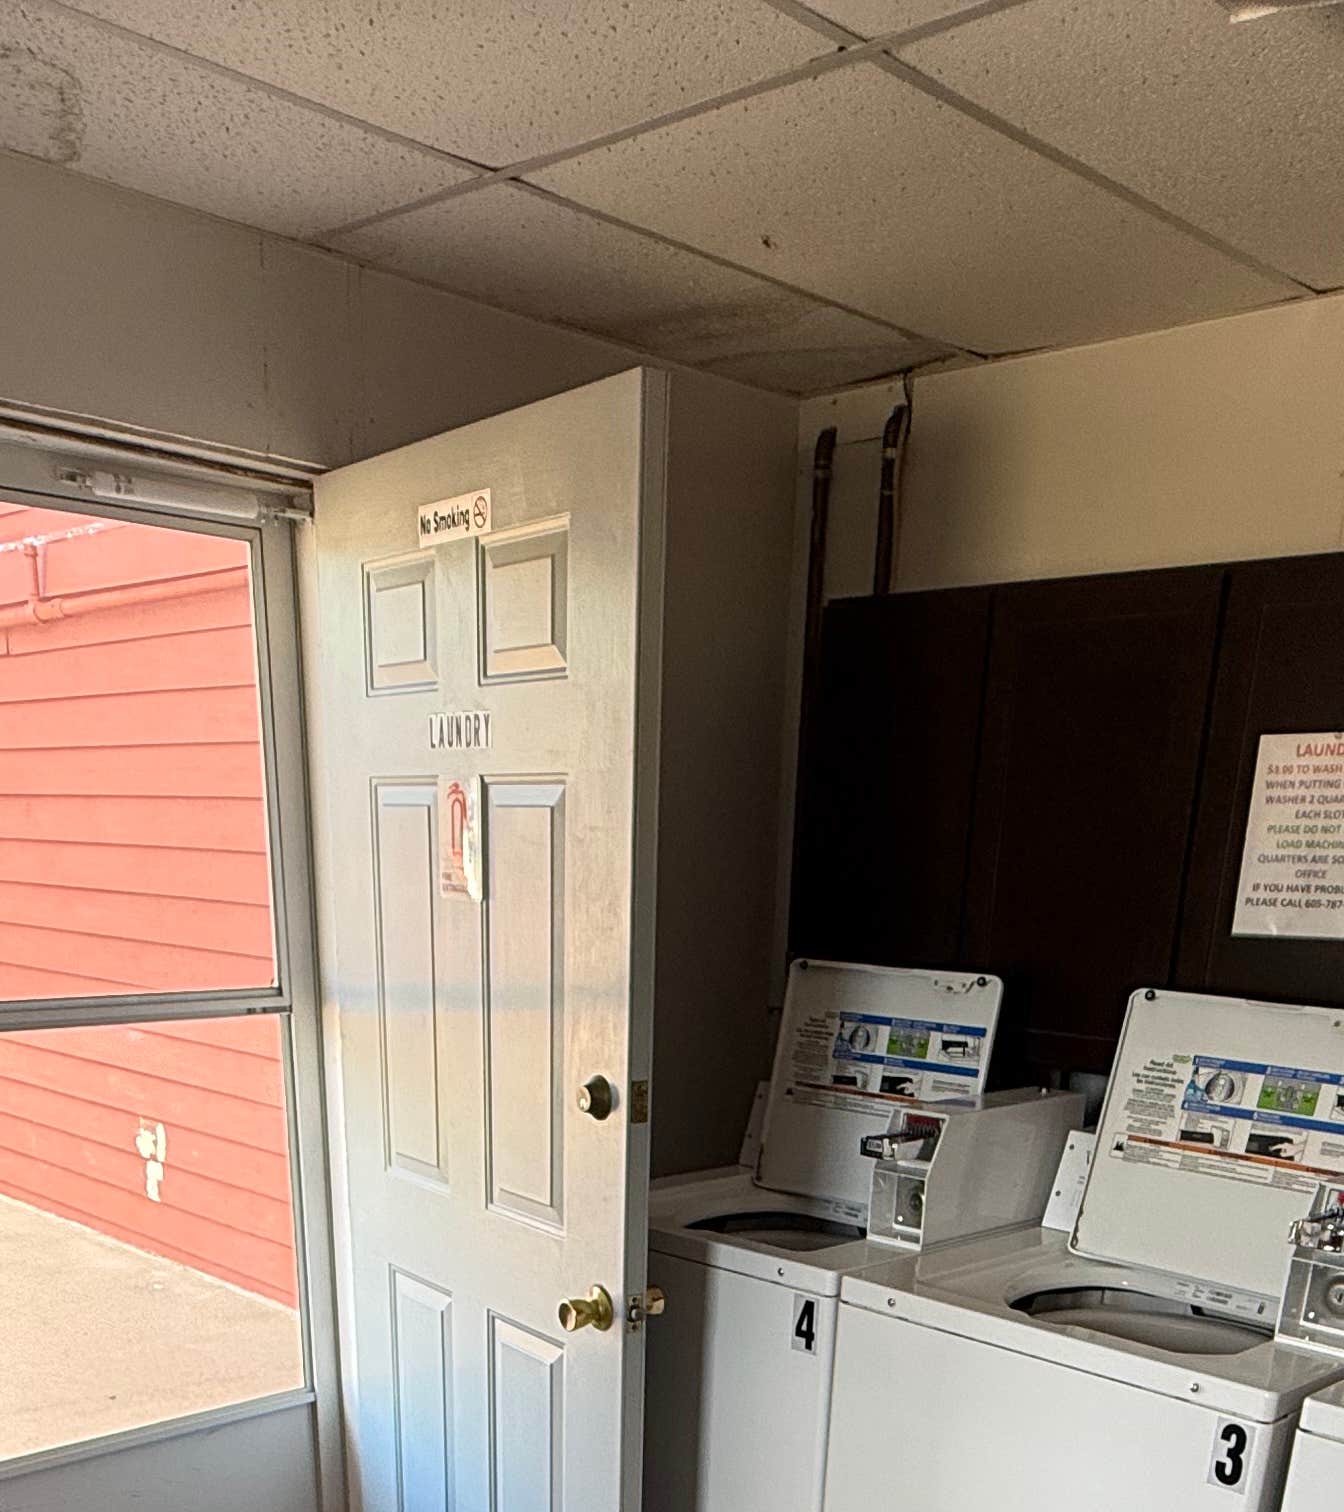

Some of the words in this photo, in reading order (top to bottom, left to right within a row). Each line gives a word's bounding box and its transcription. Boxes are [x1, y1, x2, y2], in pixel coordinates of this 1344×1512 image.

[420, 514, 431, 536] No
[433, 504, 470, 532] Smoking
[429, 713, 490, 749] LAUNDRY
[1296, 764, 1310, 774] TO
[1312, 763, 1343, 774] WASH
[1265, 780, 1296, 790] WHEN
[1298, 779, 1342, 790] PUTTING
[1265, 795, 1306, 805] WASHER
[1295, 810, 1321, 820] EACH
[1267, 825, 1302, 834] PLEASE
[1304, 825, 1318, 834] DO
[1320, 825, 1341, 834] NOT
[1276, 840, 1304, 850] LOAD
[1258, 854, 1308, 864] QUARTERS
[1310, 855, 1330, 864] ARE
[1295, 869, 1328, 879] OFFICE
[1252, 883, 1262, 892] IF
[1264, 884, 1284, 893] YOU
[1286, 884, 1312, 894] HAVE
[1245, 898, 1278, 908] PLEASE
[1280, 898, 1303, 908] CALL
[795, 1300, 814, 1351] 4
[1215, 1424, 1248, 1486] 3
